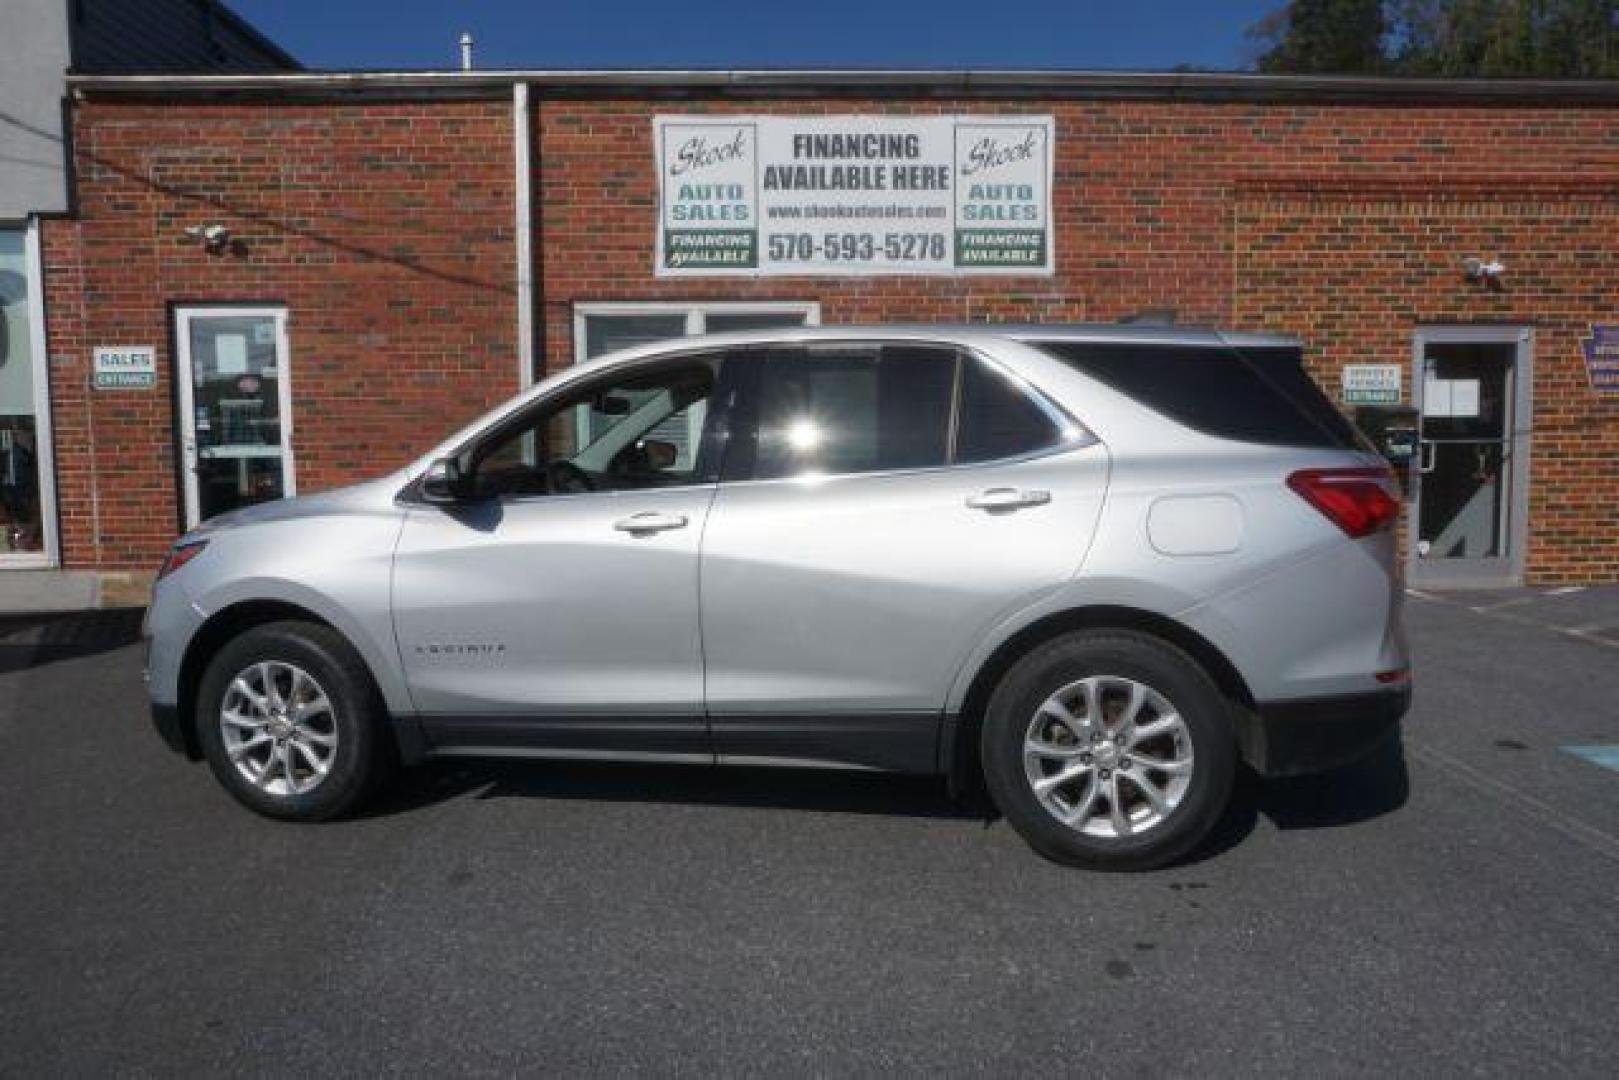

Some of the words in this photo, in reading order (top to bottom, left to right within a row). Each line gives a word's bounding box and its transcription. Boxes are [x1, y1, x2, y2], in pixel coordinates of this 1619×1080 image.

[669, 128, 746, 176] Skook
[794, 134, 919, 159] FINANCING
[961, 130, 1036, 176] Skook
[763, 166, 886, 191] AVAILABLE
[892, 166, 950, 191] HERE
[678, 185, 743, 200] AUTO
[968, 185, 1033, 200] AUTO
[672, 205, 749, 220] SALES
[963, 205, 1038, 220] SALES
[671, 234, 752, 246] FINANCING
[768, 232, 946, 261] 570-593-5278
[961, 234, 1041, 246] FINANCING
[671, 250, 750, 263] AVAILABLE
[962, 250, 1038, 262] AVAILABLE
[100, 353, 150, 366] SALES
